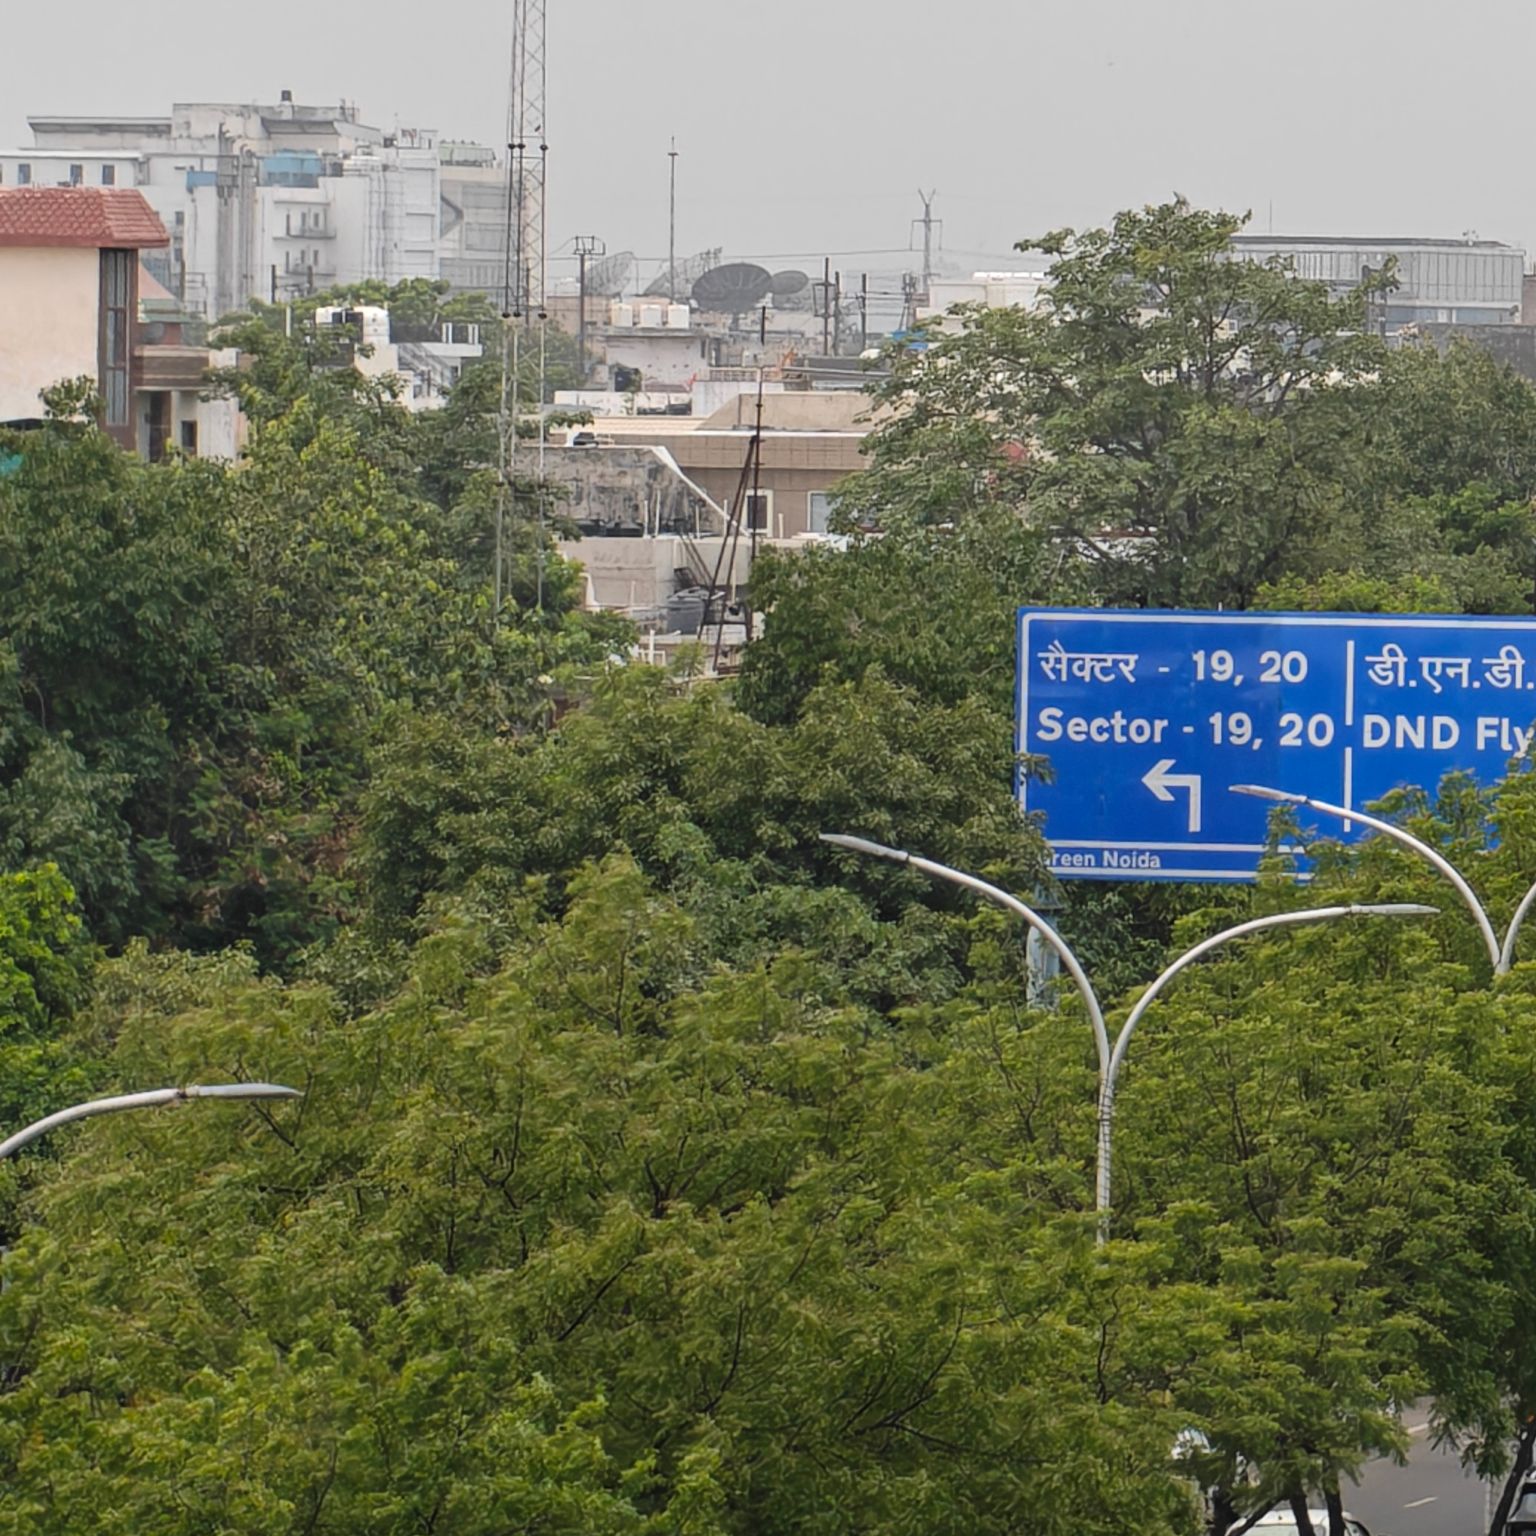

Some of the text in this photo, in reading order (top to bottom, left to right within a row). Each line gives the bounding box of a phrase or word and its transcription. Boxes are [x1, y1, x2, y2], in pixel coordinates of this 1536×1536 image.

[1037, 640, 1138, 684] सैक्टर
[1193, 650, 1244, 686] 19,
[1259, 650, 1308, 683] 20
[1036, 707, 1169, 745] Sector
[1209, 712, 1262, 751] 19,
[1279, 713, 1335, 748] 20
[1363, 714, 1460, 750] DND
[1045, 849, 1161, 868] reen Noida
